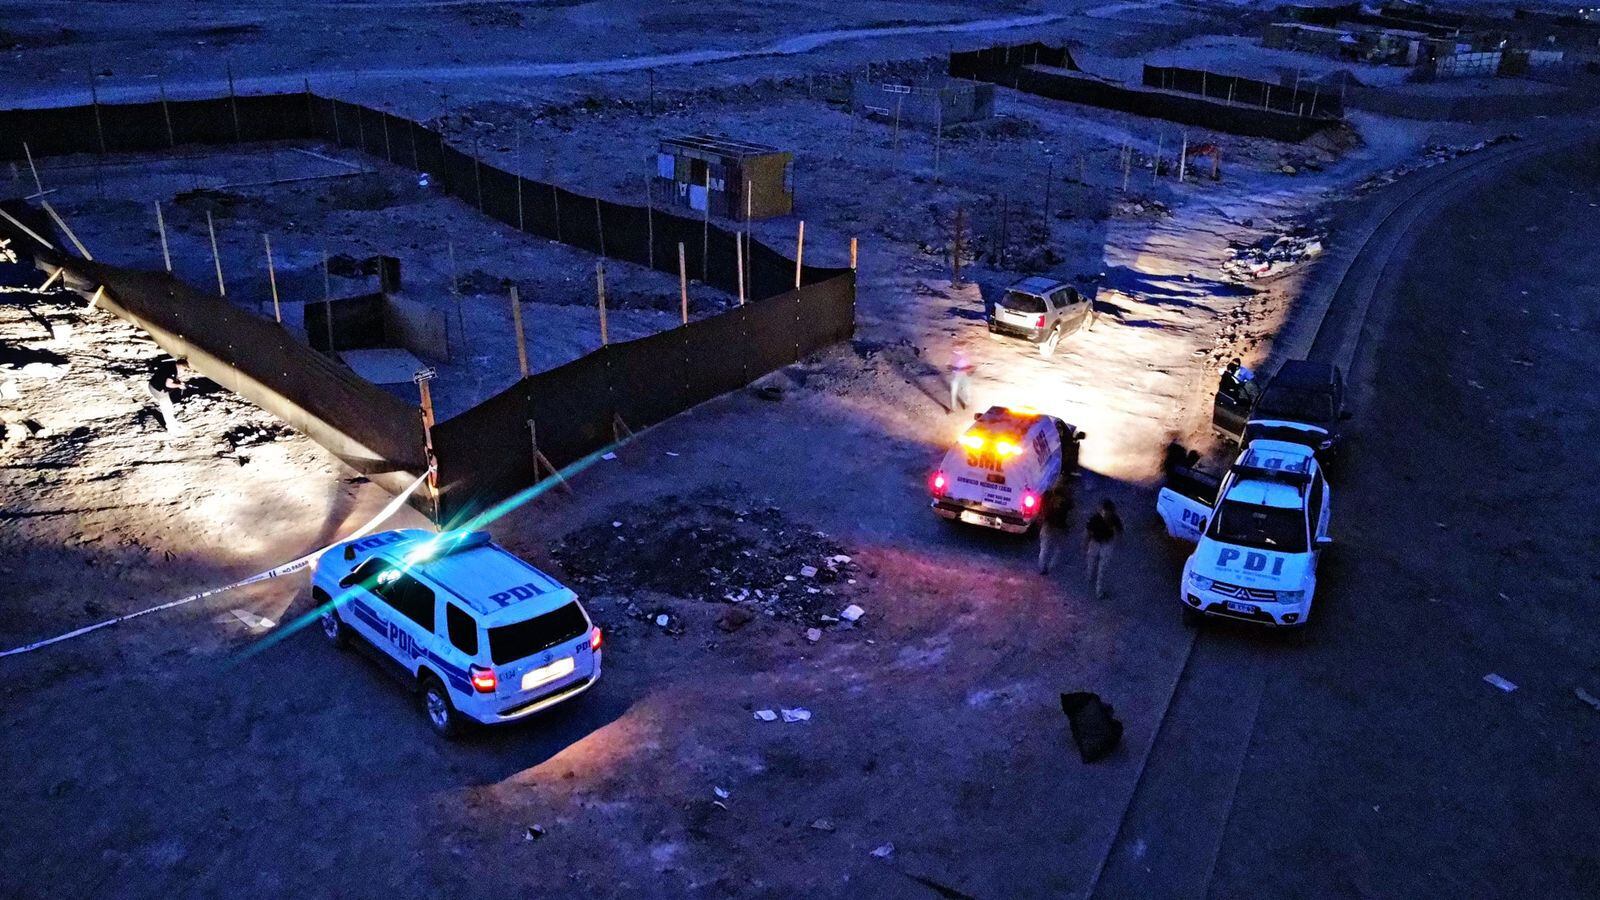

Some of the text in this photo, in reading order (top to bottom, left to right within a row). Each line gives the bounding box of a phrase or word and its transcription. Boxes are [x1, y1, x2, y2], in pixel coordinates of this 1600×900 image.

[967, 450, 1003, 472] SML
[1182, 508, 1206, 526] PD
[1217, 547, 1285, 576] PDI
[488, 582, 547, 608] PDI
[390, 621, 412, 656] PDI
[576, 640, 591, 654] PDI
